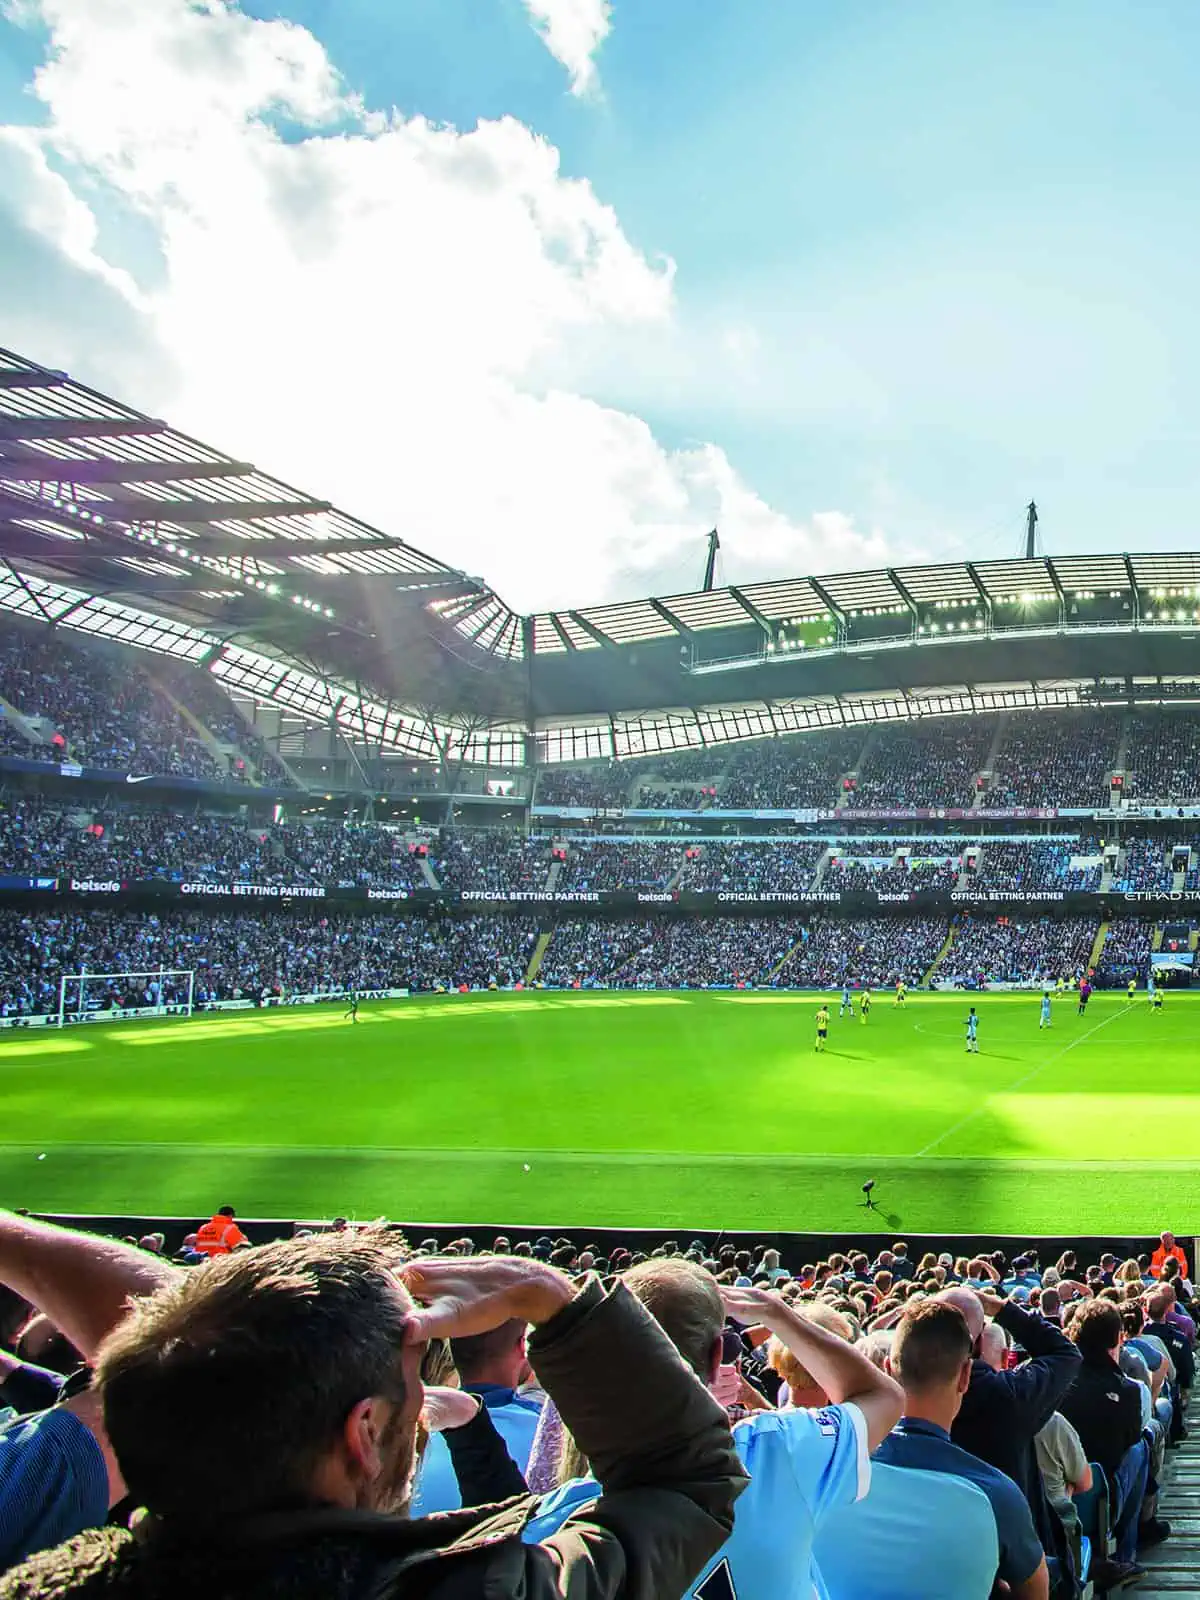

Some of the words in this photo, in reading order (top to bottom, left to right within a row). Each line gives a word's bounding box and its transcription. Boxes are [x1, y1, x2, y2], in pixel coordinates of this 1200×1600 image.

[71, 879, 121, 892] betsafe
[180, 883, 231, 895] OFFICIAL
[233, 885, 278, 896] BETTING
[280, 886, 326, 898] PARTNER
[367, 888, 408, 899] betsafe
[461, 891, 507, 901] OFFICIAL
[510, 891, 553, 901] BETTING
[555, 891, 599, 901] PARTNER
[637, 892, 673, 902] betsafe
[718, 892, 758, 901] OFFICIAL
[760, 892, 799, 901] BETTING
[800, 892, 841, 901] PARTNER
[877, 891, 910, 901] betsafe
[950, 892, 988, 901] OFFICIAL
[989, 892, 1025, 901] BETTING
[1026, 892, 1064, 901] PARTNER
[1124, 891, 1182, 901] ETIHAD
[359, 991, 391, 1000] HAYS
